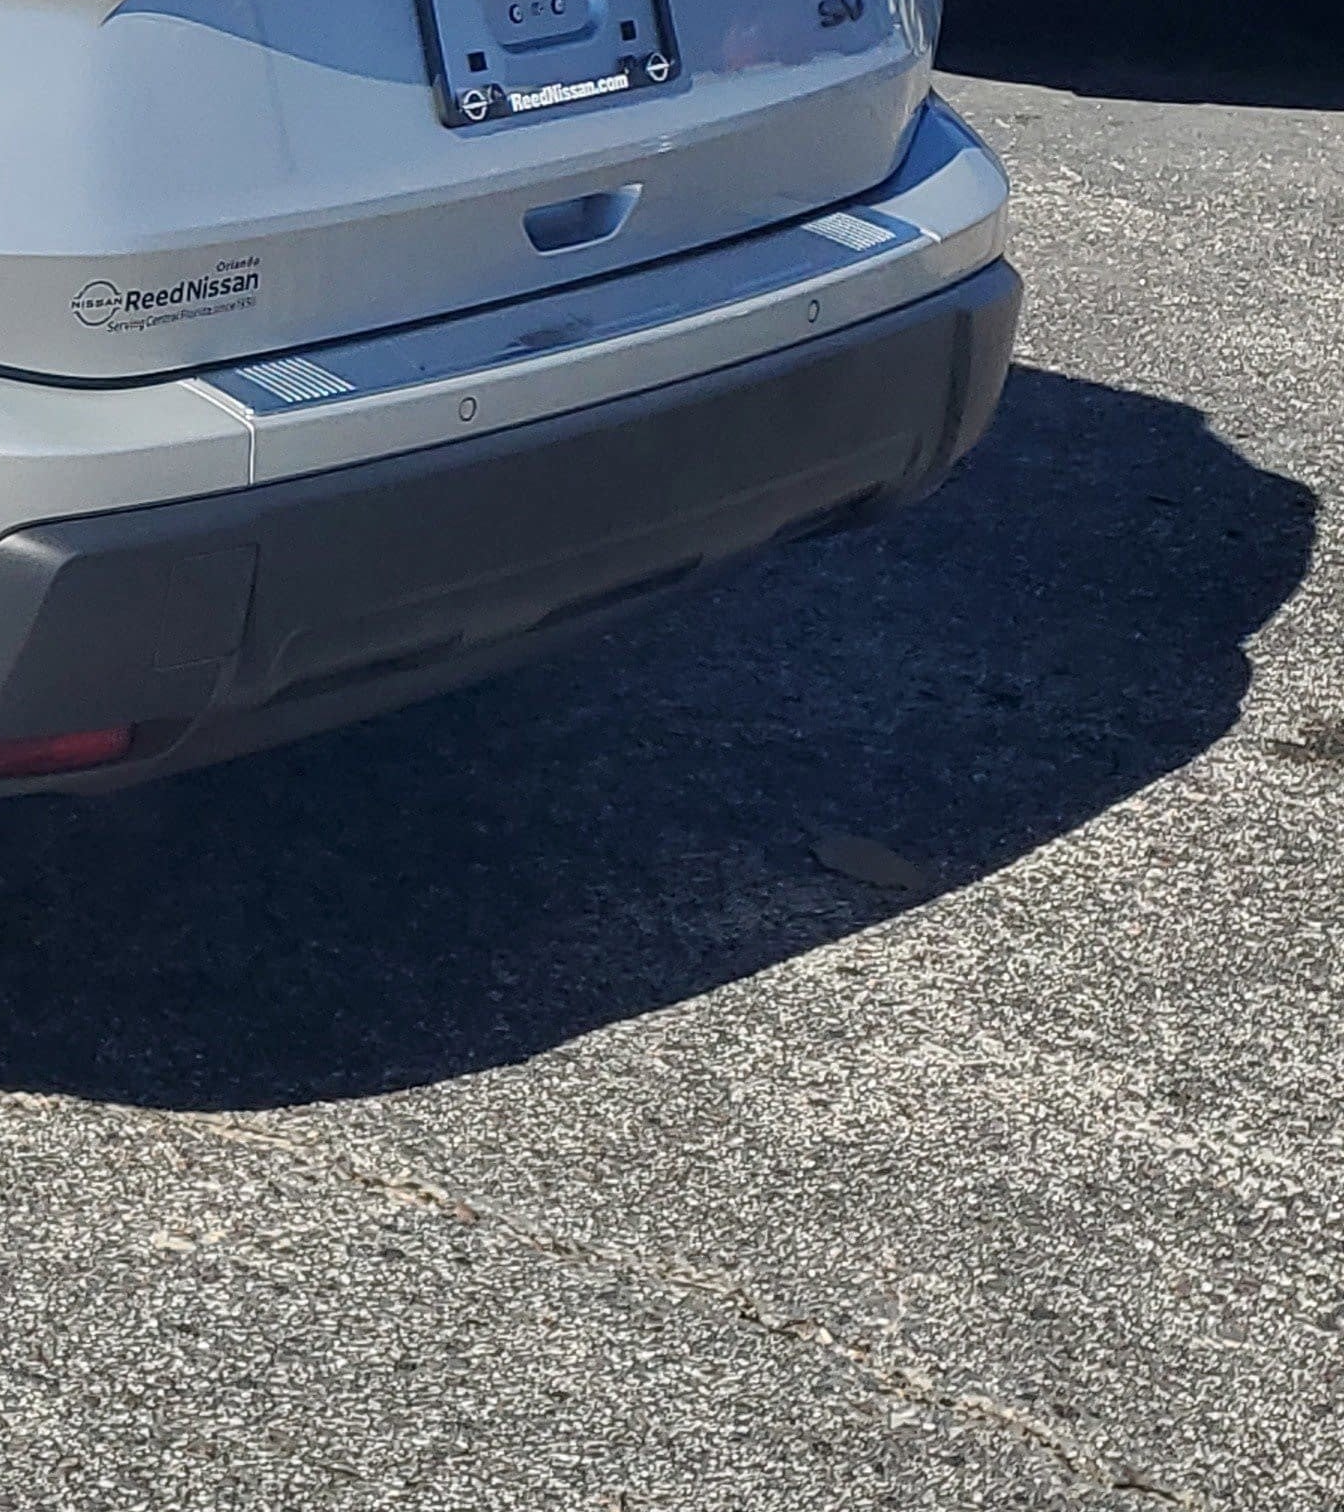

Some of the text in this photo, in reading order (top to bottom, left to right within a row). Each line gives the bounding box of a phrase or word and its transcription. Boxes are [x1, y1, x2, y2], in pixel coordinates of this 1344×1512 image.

[510, 73, 630, 113] ReedNissan.com
[215, 256, 261, 273] Orlando
[71, 296, 123, 310] NISSAN
[124, 272, 259, 312] Reed Nissan
